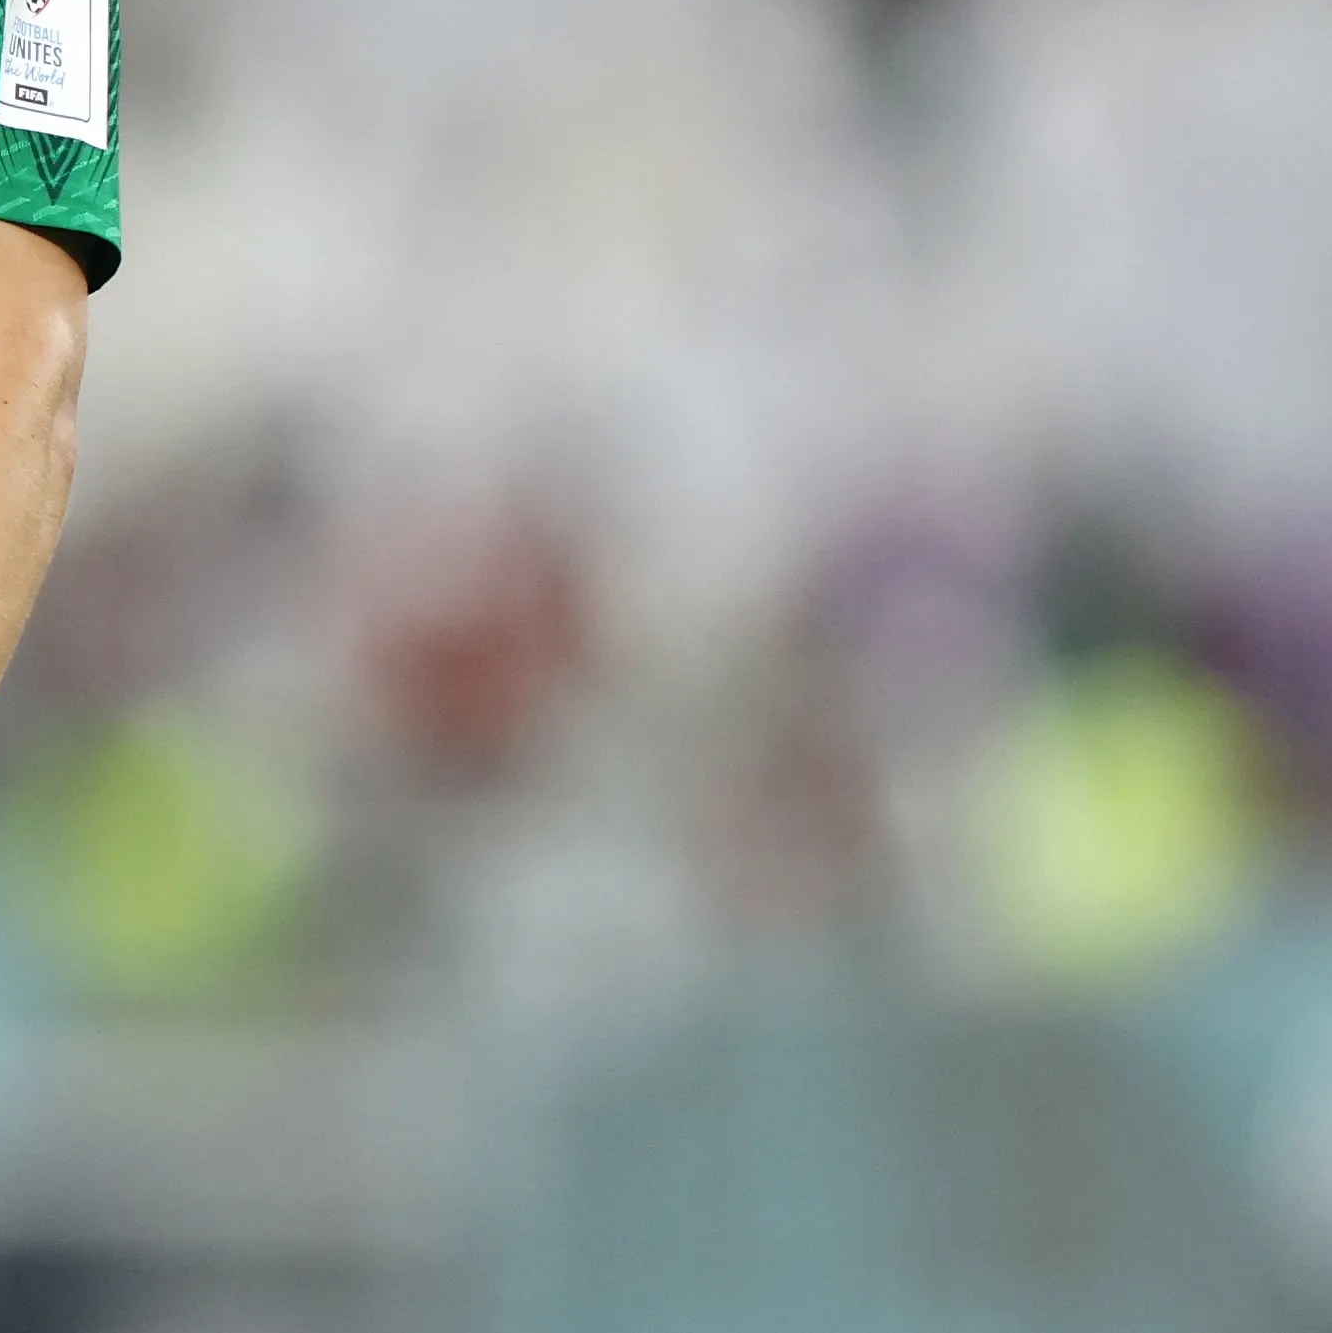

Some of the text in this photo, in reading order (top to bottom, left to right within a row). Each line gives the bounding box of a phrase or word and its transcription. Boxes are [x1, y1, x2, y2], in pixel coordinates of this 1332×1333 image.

[13, 15, 63, 45] FOOTBALL
[9, 32, 62, 67] UNITES
[5, 57, 66, 90] the World
[17, 86, 46, 103] FIFA
